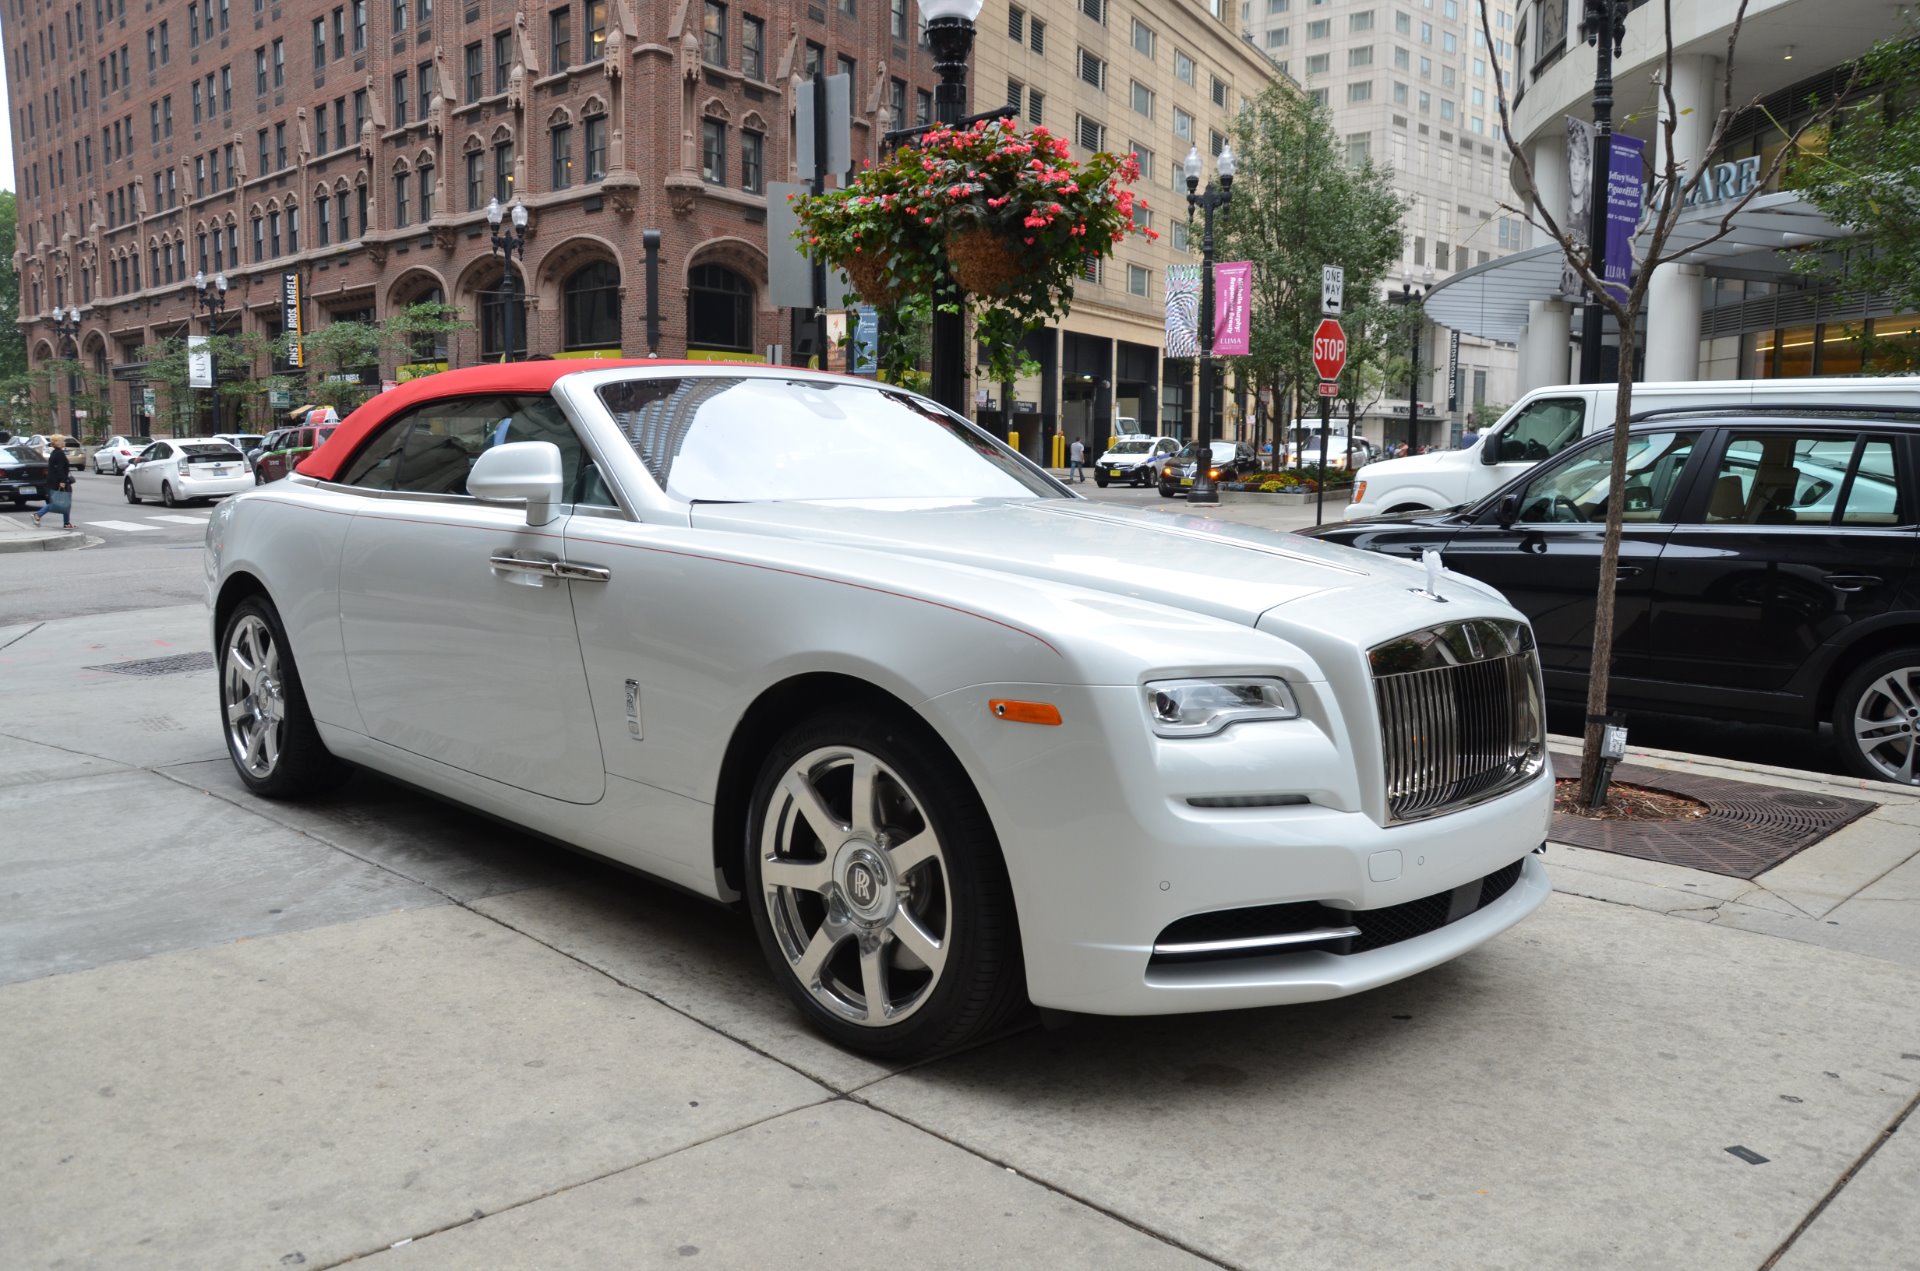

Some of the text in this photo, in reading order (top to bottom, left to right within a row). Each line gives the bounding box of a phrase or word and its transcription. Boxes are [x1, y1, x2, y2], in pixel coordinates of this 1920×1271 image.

[1325, 270, 1341, 283] ONE
[1605, 264, 1627, 280] LUMA
[286, 275, 297, 305] BAGELS
[1325, 283, 1341, 296] WAY
[1226, 312, 1235, 334] Beauty
[1220, 337, 1242, 345] LUMA
[1315, 337, 1345, 361] STOP
[1450, 333, 1458, 378] NORDSTROM
[1320, 385, 1336, 394] ALL WAY
